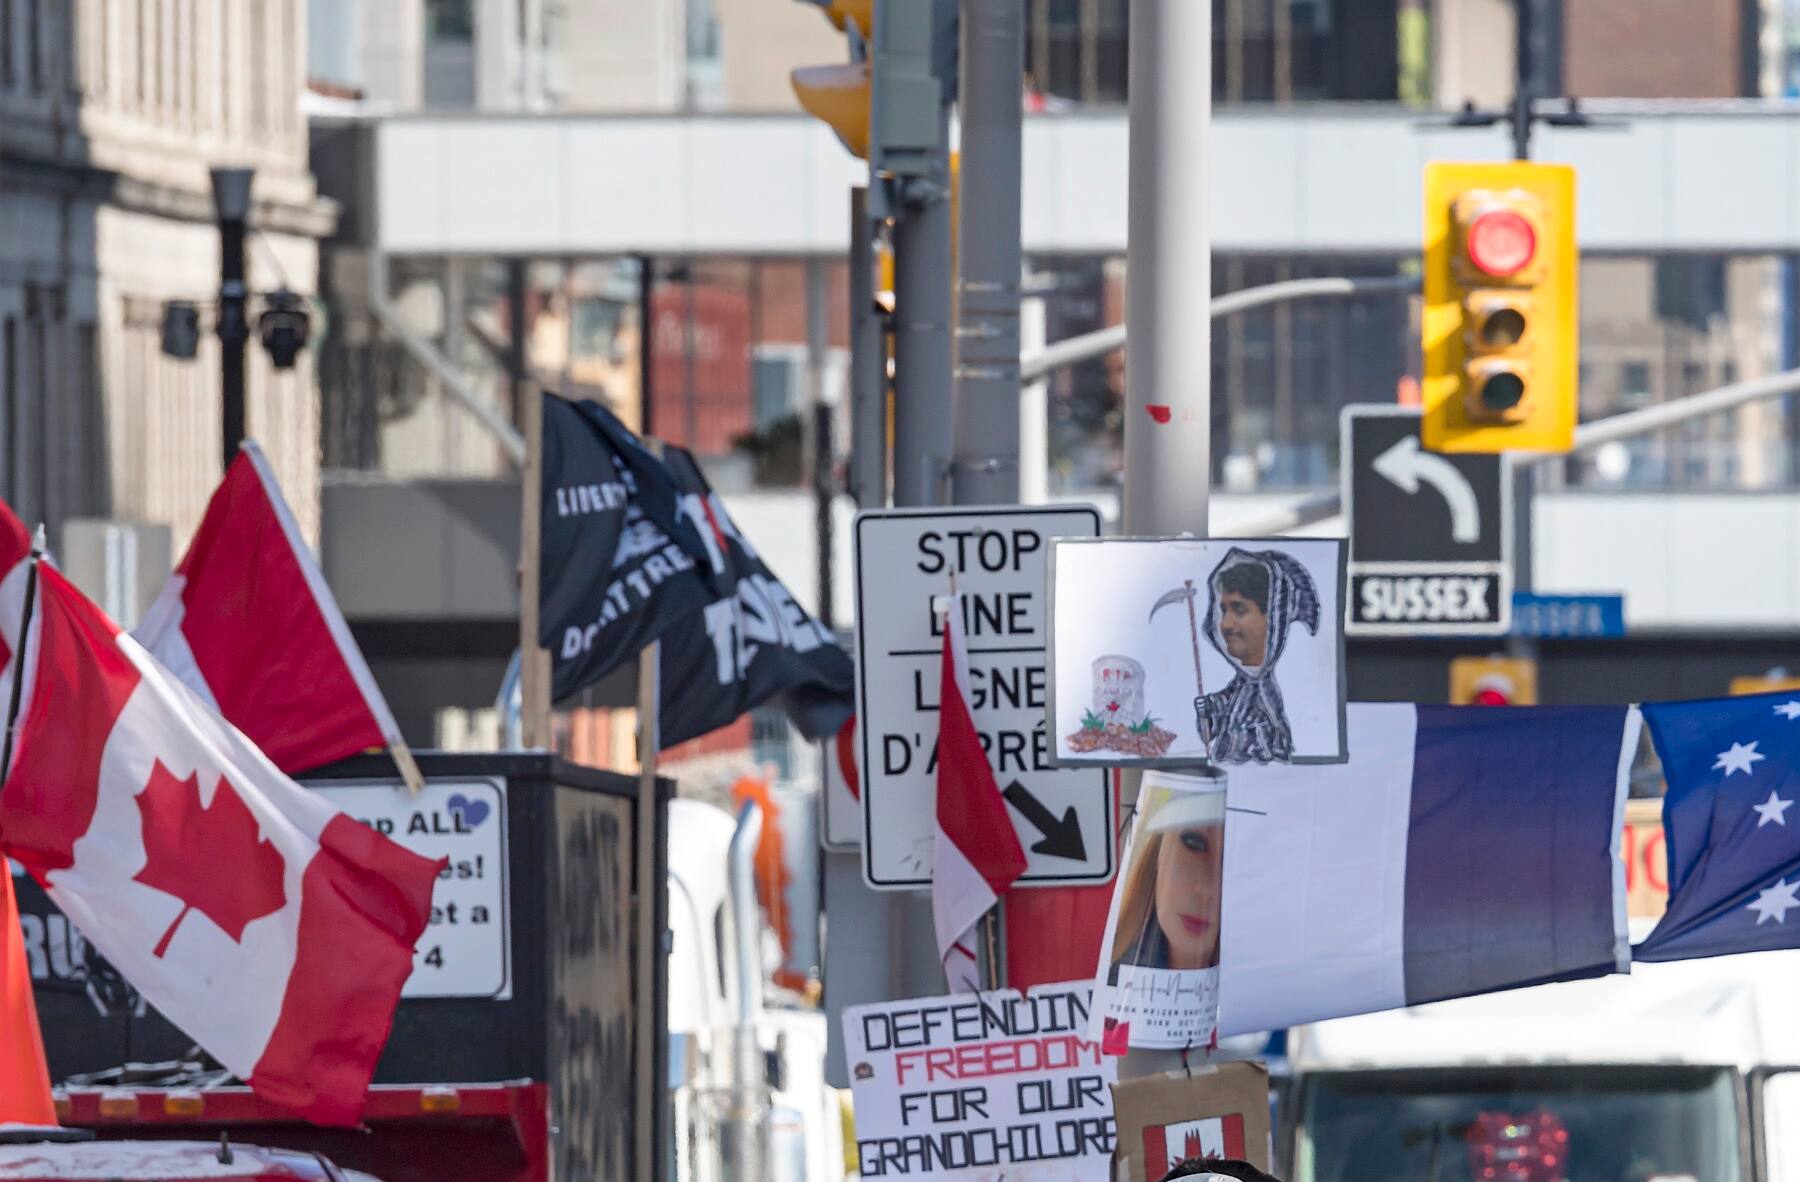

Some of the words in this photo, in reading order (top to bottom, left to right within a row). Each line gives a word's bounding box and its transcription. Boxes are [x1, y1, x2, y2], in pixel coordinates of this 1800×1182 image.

[917, 529, 1041, 574] STOP
[1362, 578, 1490, 620] SUSSEX
[408, 811, 472, 834] ALL
[862, 988, 1093, 1052] DEFENDIN
[895, 1036, 1100, 1086] FREEDOM
[899, 1087, 989, 1126] FOR
[1016, 1075, 1104, 1115] OUR
